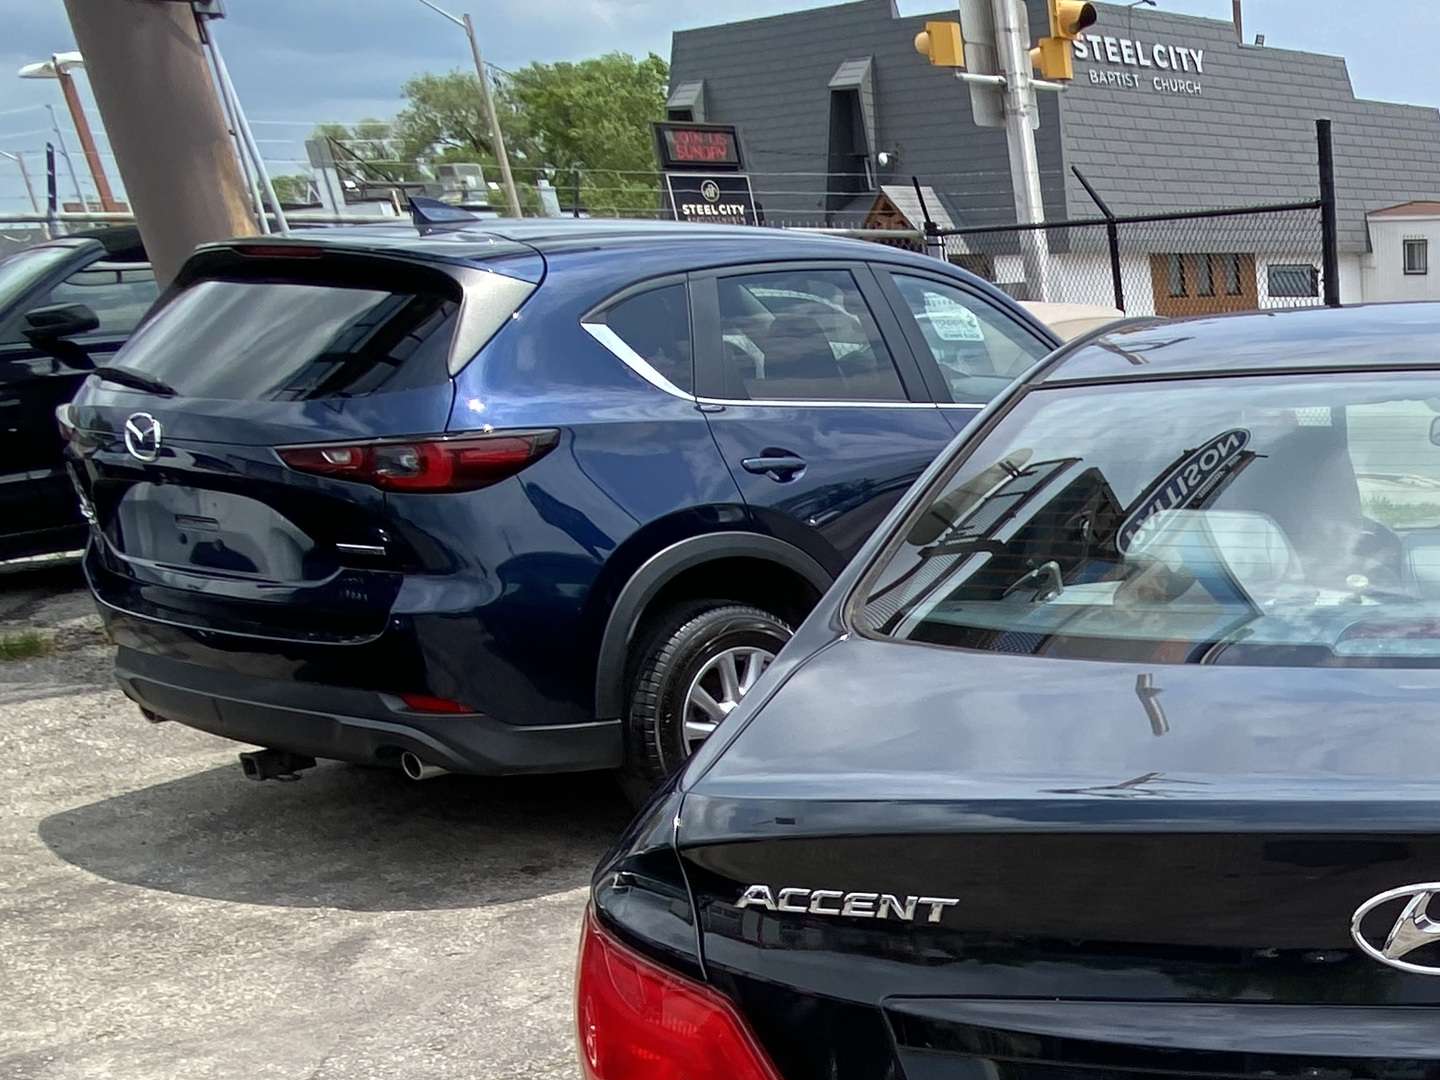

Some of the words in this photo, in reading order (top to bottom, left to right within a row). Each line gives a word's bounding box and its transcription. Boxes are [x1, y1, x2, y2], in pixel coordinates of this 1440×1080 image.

[1089, 69, 1139, 88] BAPTIST
[1153, 76, 1202, 95] CHURCH
[734, 884, 960, 923] ACCENT
